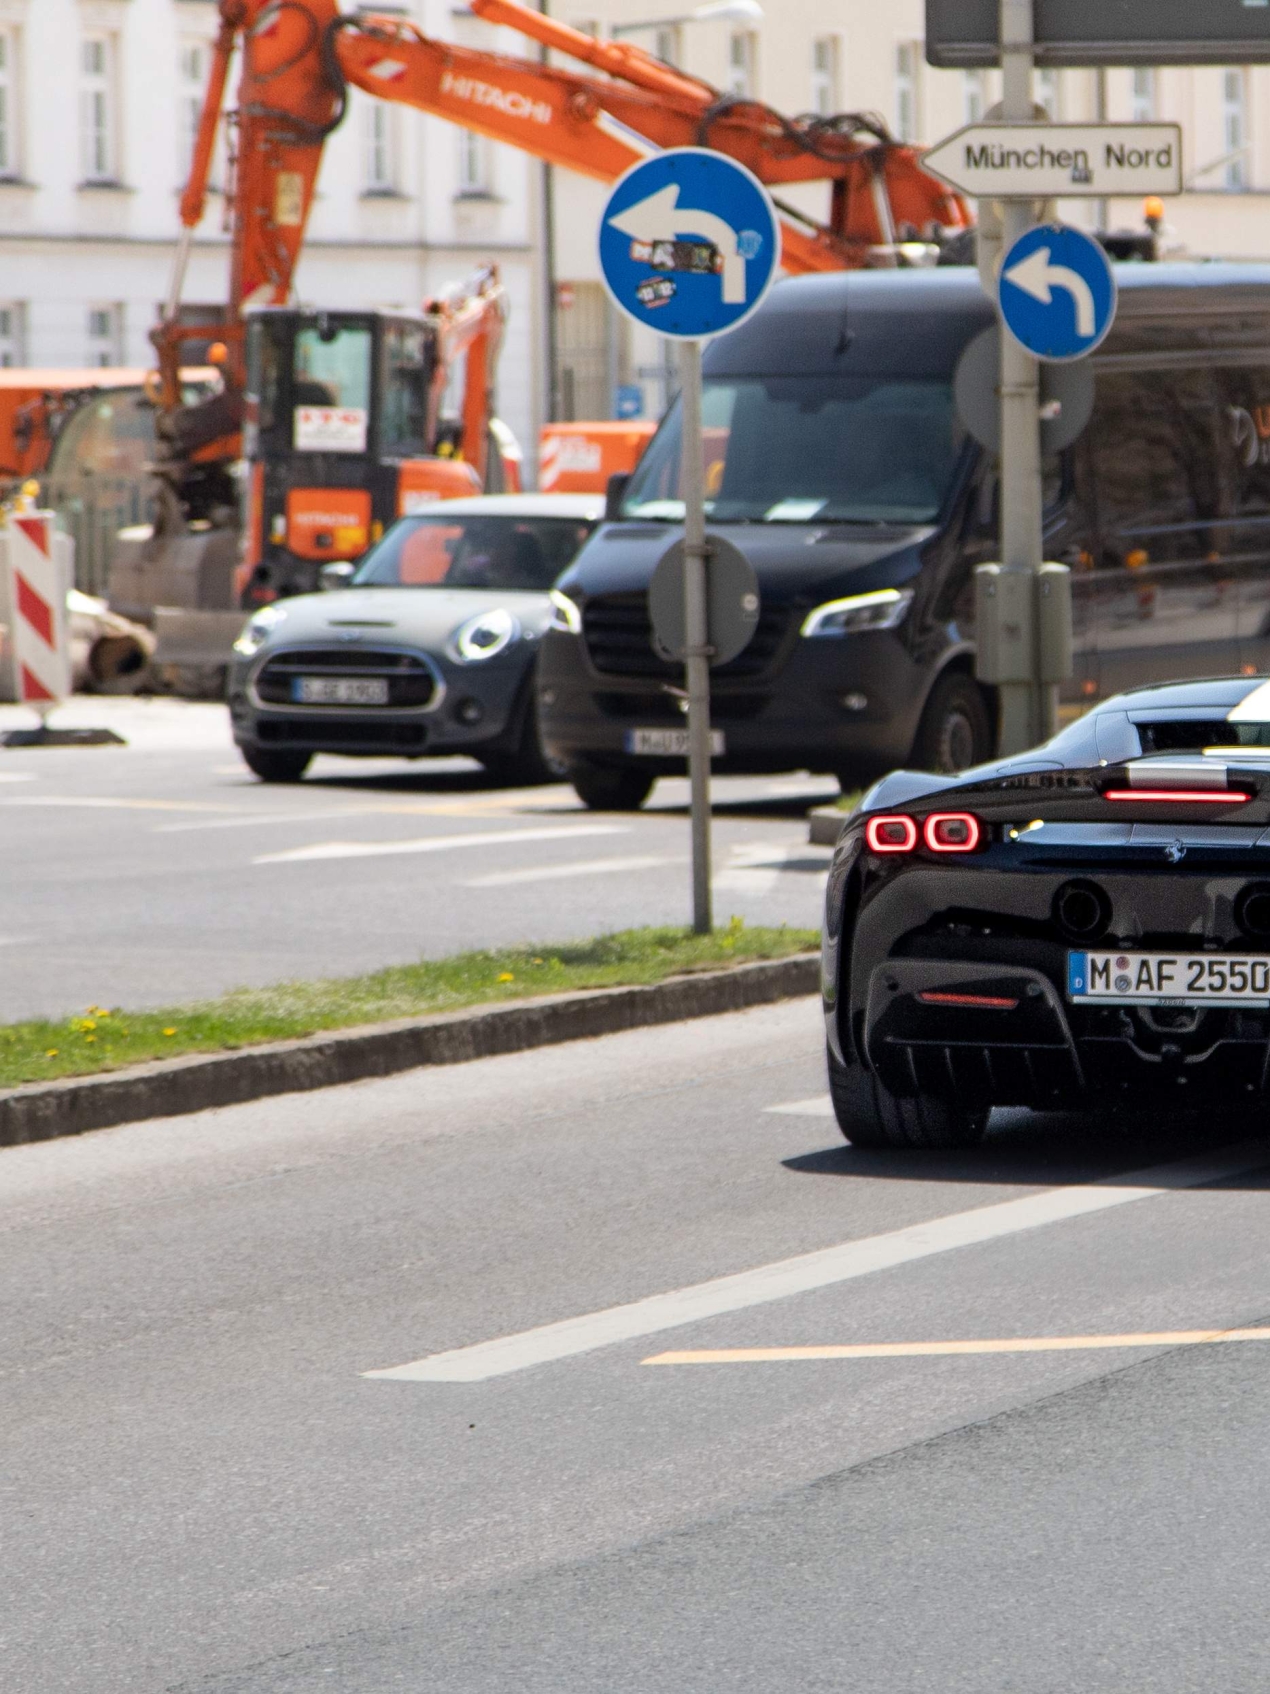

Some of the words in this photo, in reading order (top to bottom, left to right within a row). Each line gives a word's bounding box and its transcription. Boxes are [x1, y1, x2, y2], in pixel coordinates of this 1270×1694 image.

[440, 71, 552, 125] HITACHI
[965, 143, 1089, 169] München
[1104, 143, 1173, 169] Nord
[1090, 957, 1111, 991] M
[1135, 959, 1178, 991] AF
[1186, 960, 1270, 994] 2550
